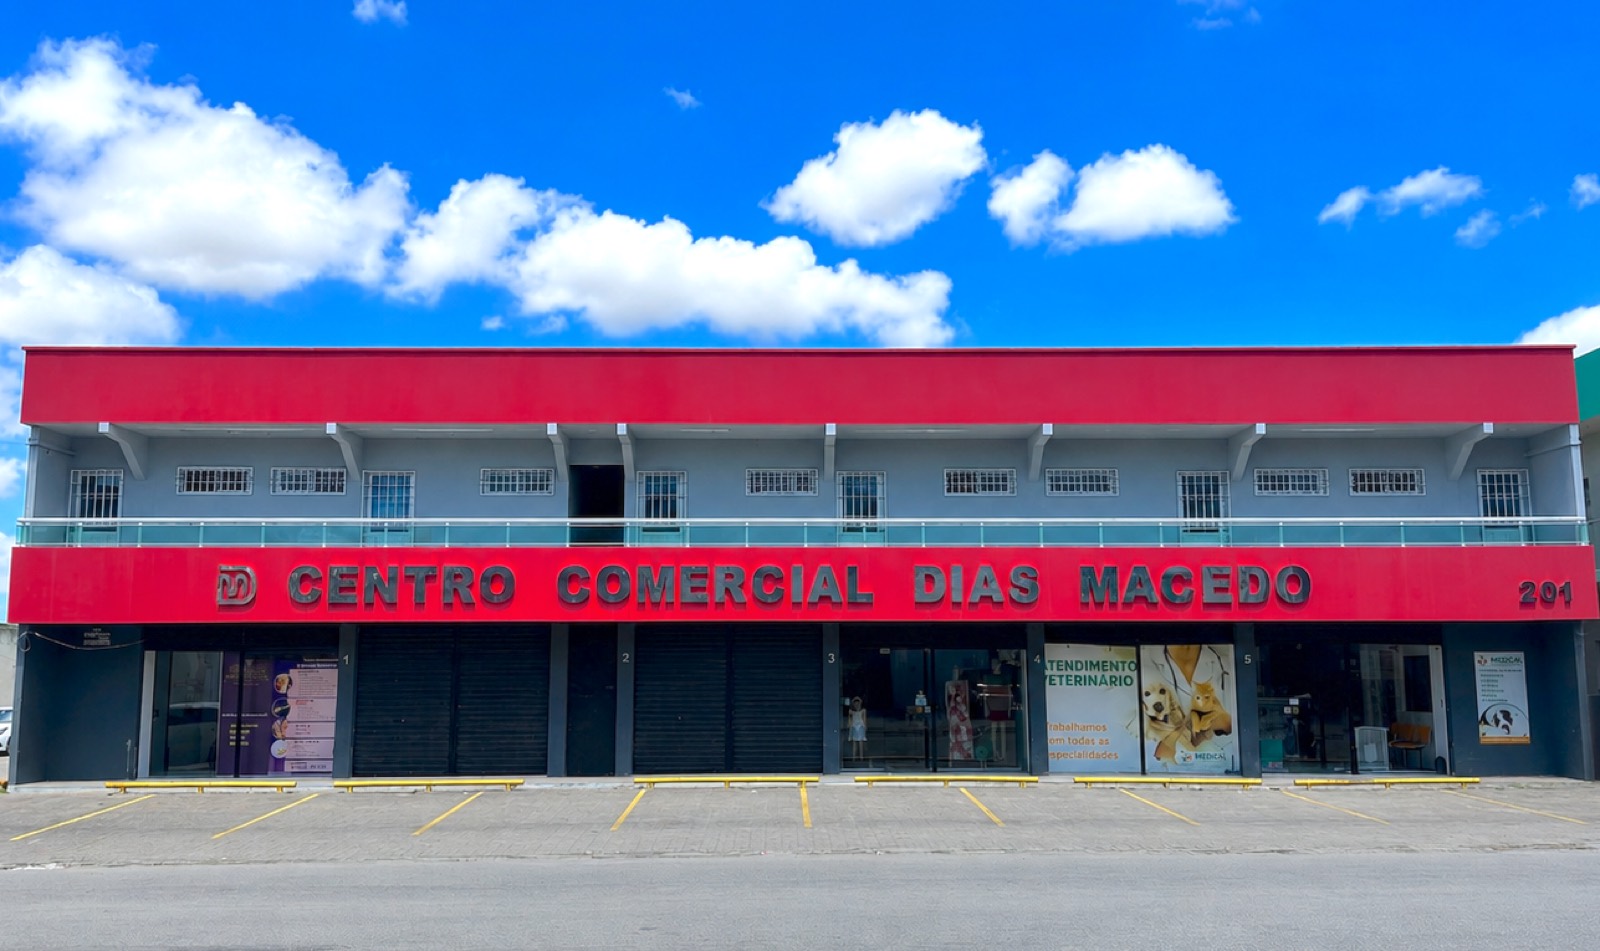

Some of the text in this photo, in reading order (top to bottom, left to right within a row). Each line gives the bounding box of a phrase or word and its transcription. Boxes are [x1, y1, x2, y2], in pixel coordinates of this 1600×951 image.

[288, 564, 1312, 606] CENTRO COMERCIAL DIAS MACEDO
[1517, 580, 1574, 605] 201
[342, 654, 349, 665] 1
[621, 653, 630, 664] 2
[827, 653, 835, 664] 3
[1033, 654, 1041, 664] 4
[1244, 654, 1252, 664] 5
[1047, 721, 1108, 732] rabalhamos
[1049, 736, 1110, 746] om todas as
